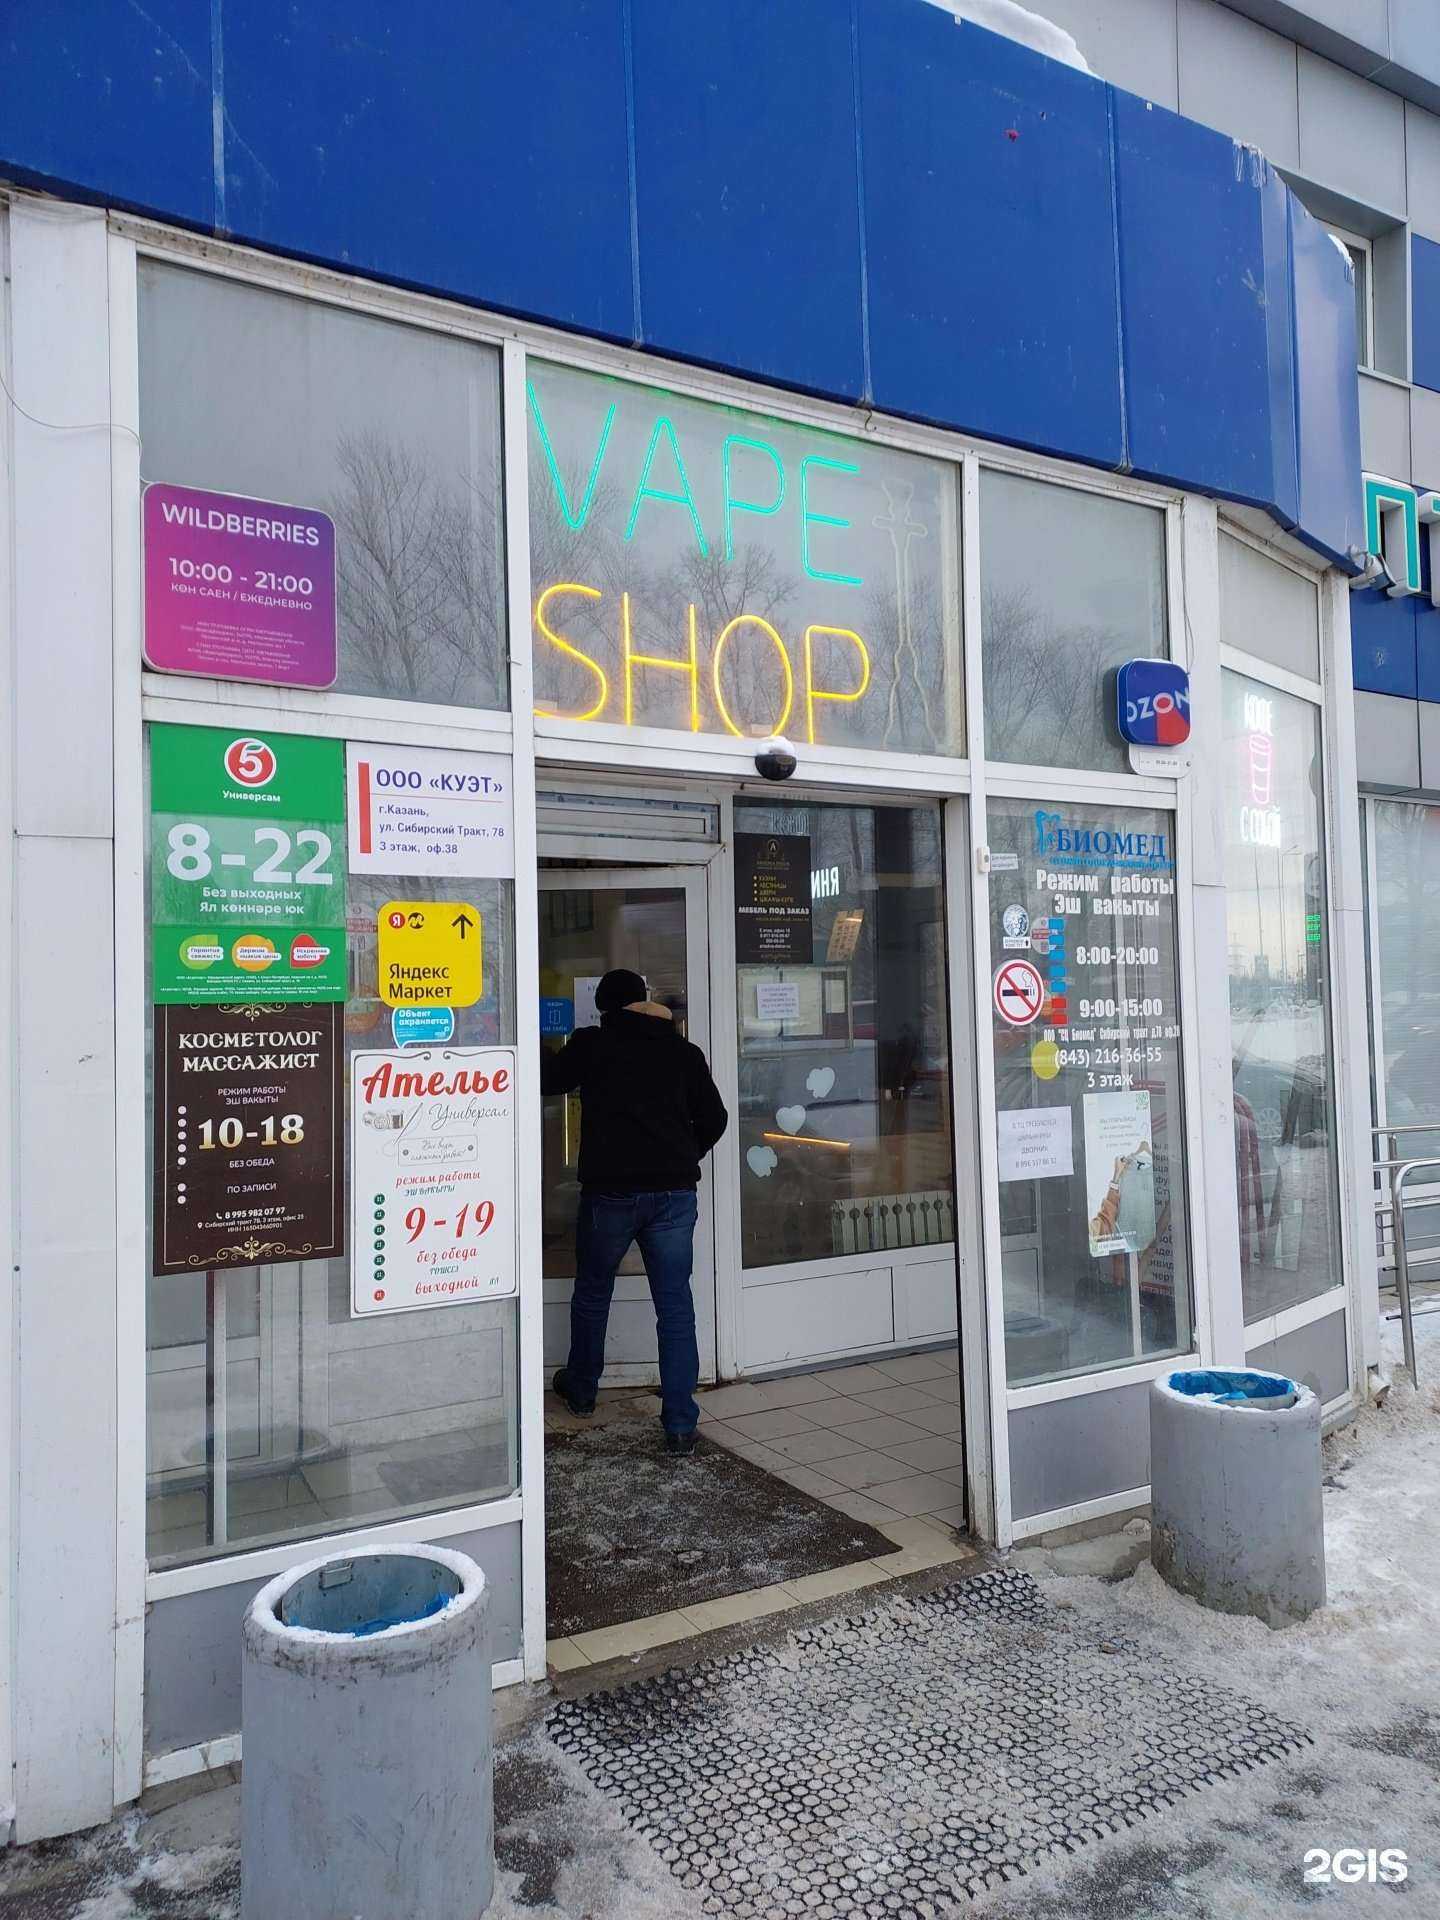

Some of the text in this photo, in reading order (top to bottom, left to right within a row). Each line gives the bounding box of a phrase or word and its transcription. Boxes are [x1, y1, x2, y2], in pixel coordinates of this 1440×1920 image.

[528, 382, 864, 586] VAPE
[161, 502, 320, 546] WILDBERRIES
[169, 557, 233, 583] 10:00
[254, 571, 313, 595] 21:00
[199, 585, 231, 599] САЕН
[240, 592, 313, 610] ЕЖЕДНЕВНО
[533, 583, 870, 745] SHOP
[1127, 688, 1190, 722] OZON
[376, 769, 503, 794] ООО «КУЭТ»
[222, 790, 281, 803] Универсам
[378, 804, 430, 818] г.Казань,
[379, 822, 505, 838] ул. Сибирский Тракт, 78
[379, 841, 458, 855] 3 этаж, оф.38
[1057, 828, 1166, 861] БИОМЕД
[1036, 868, 1175, 895] Режим работы
[203, 886, 302, 900] Без выходных
[200, 902, 217, 914] Ял
[285, 905, 305, 915] юк
[738, 906, 768, 914] МЕБЕЛЬ
[769, 907, 786, 915] ПОД
[1054, 893, 1160, 917] Эш вакыты
[1076, 946, 1159, 965] 8:00-20:00
[389, 963, 450, 980] Яндекс
[389, 983, 453, 1001] Маркет
[1079, 998, 1163, 1018] 9:00-15:00
[178, 1030, 323, 1049] КОСМЕТОЛОГ
[182, 1053, 320, 1073] МАССАЖИСТ
[1055, 1046, 1162, 1069] (843) 216-36-55
[362, 1062, 510, 1104] Ателье
[1087, 1072, 1135, 1088] 3 этаж
[217, 1085, 287, 1097] РЕЖИМ РАБОТЫ
[225, 1096, 279, 1105] ЭШ ВАКЫТЫ
[198, 1113, 305, 1150] 10-18
[229, 1158, 276, 1169] БЕЗ ОБЕДА
[227, 1183, 277, 1194] ПО ЗАПИСИ
[395, 1170, 481, 1189] режим работы
[224, 1206, 286, 1219] 8 995 982 07 97
[416, 1247, 478, 1265] без обеда
[415, 1276, 480, 1295] выходной
